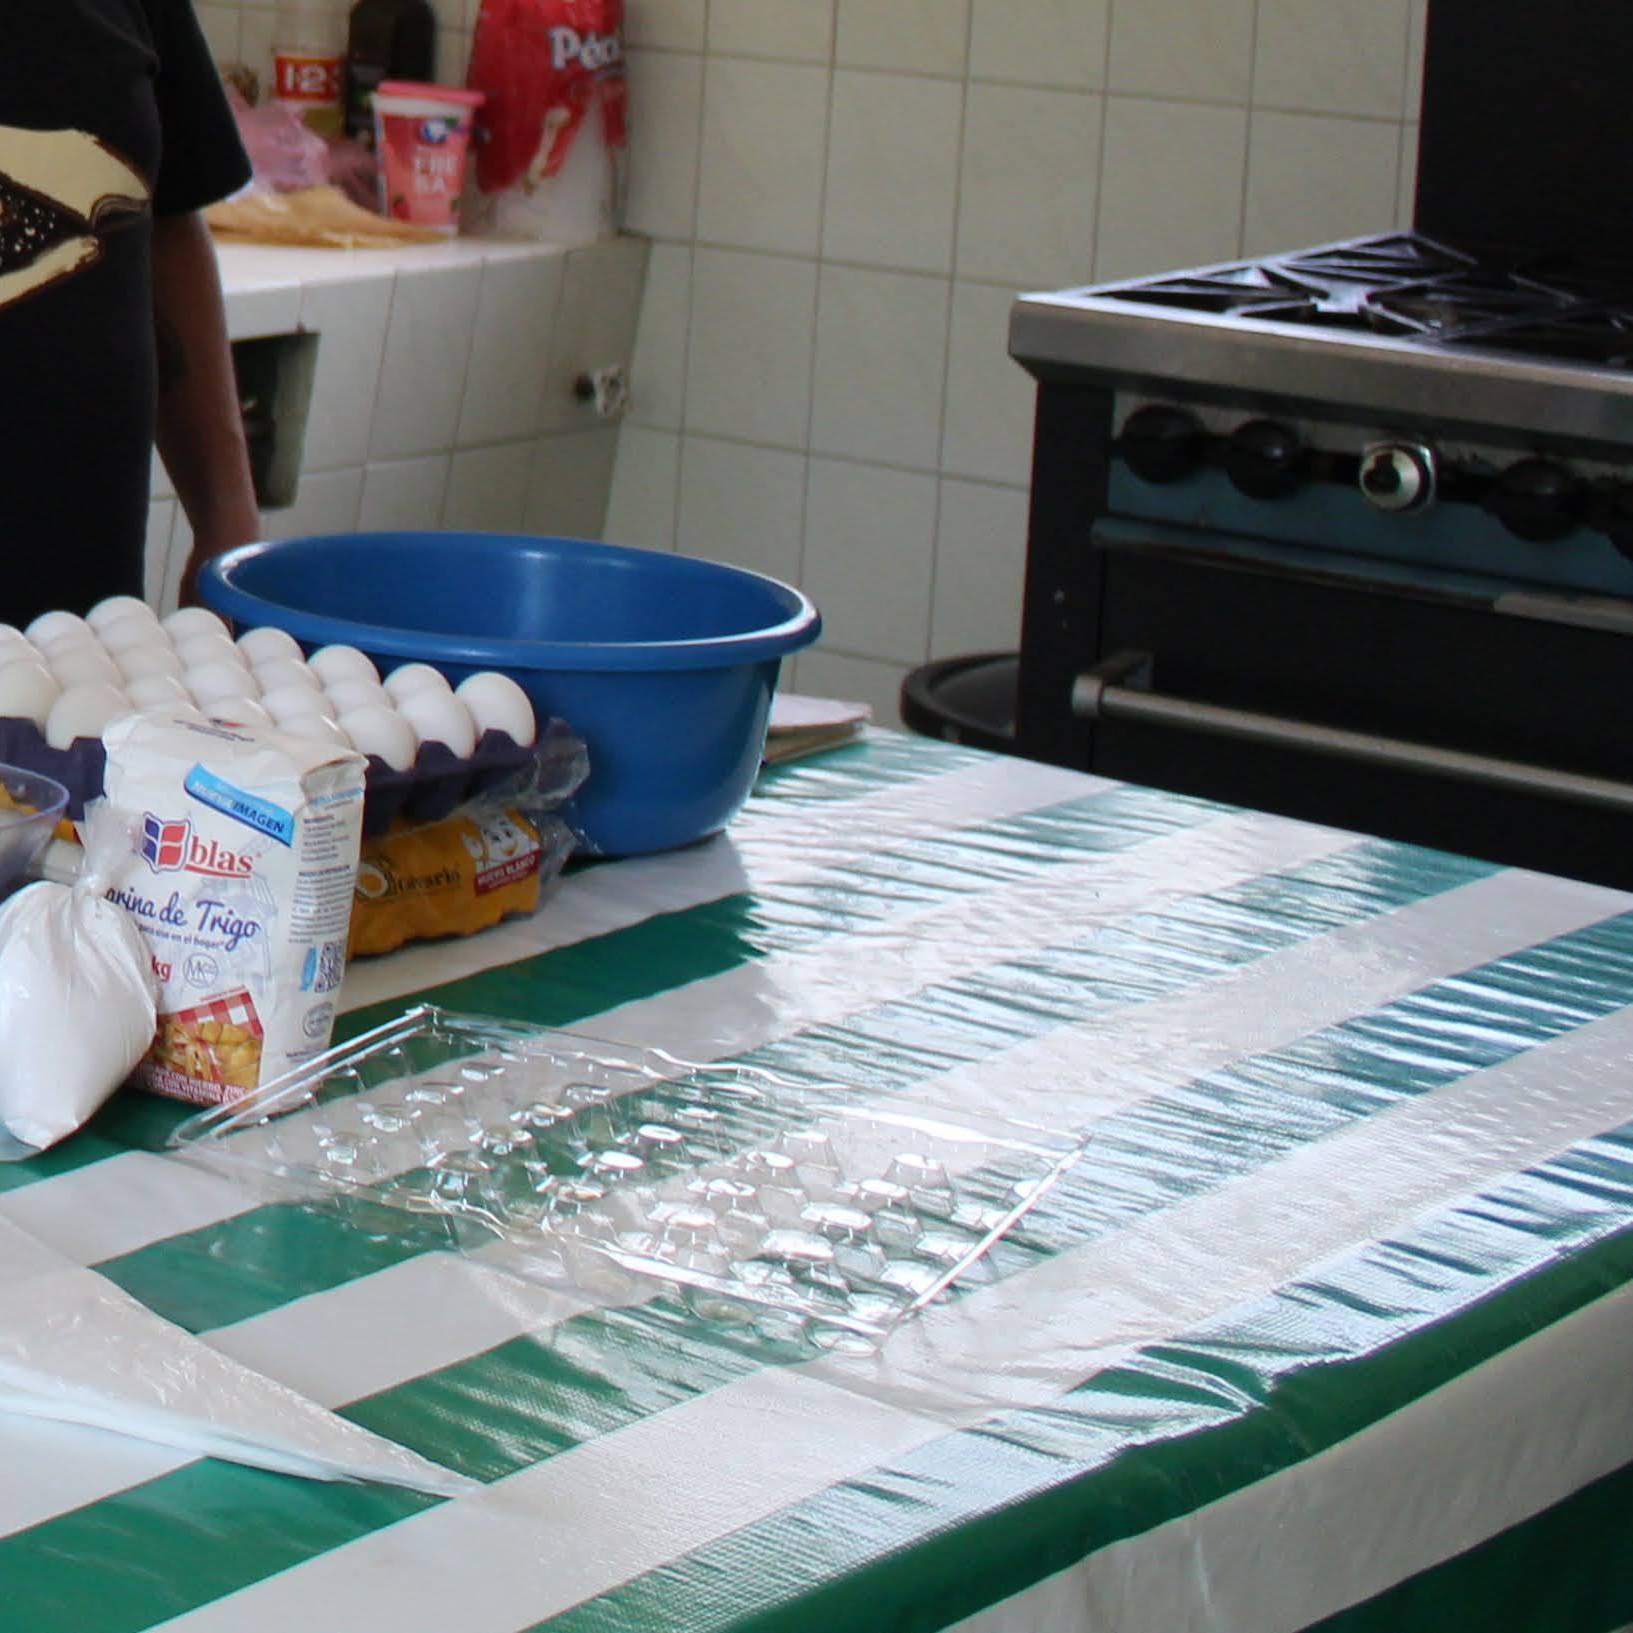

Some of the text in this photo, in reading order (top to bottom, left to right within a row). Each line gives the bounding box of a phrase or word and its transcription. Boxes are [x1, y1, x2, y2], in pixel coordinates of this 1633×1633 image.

[232, 801, 286, 834] IMAGEN
[190, 833, 253, 874] blas
[159, 890, 188, 927] de
[195, 898, 262, 952] Trigo
[151, 954, 172, 983] kg
